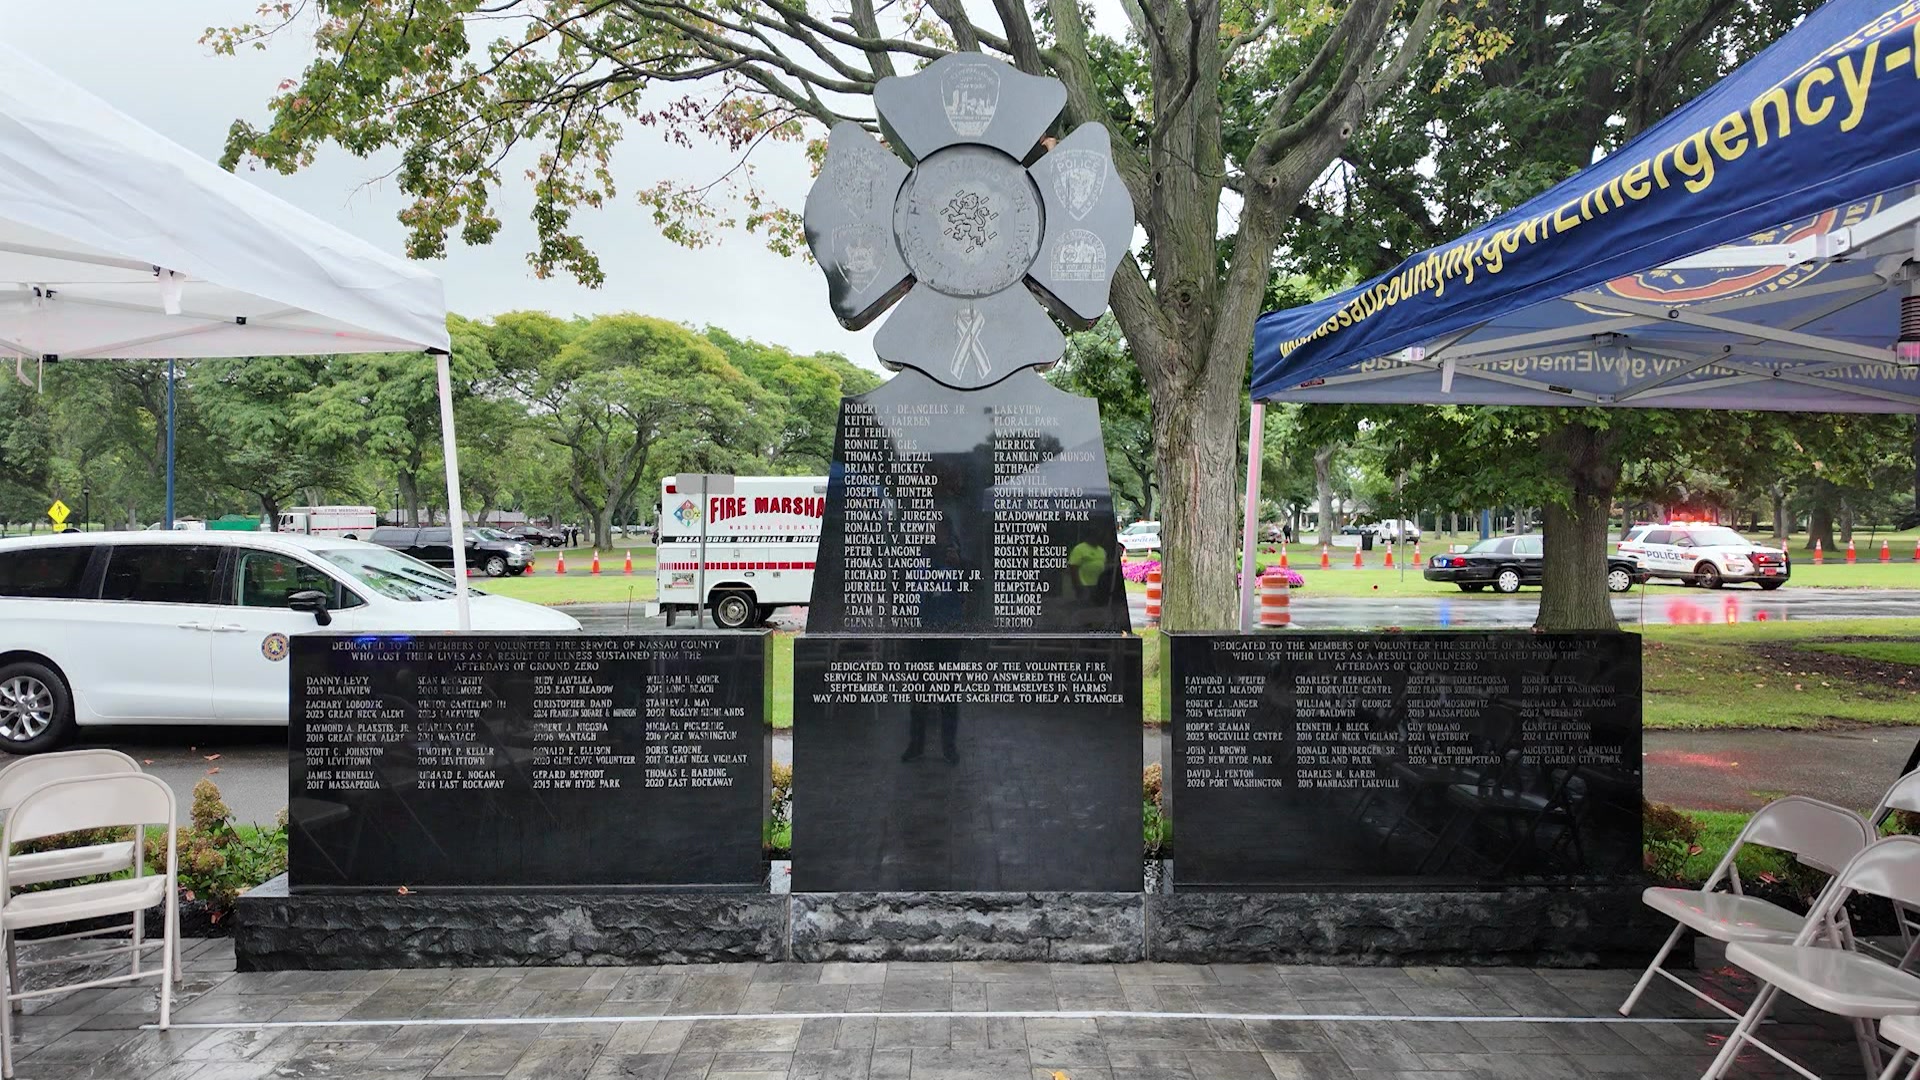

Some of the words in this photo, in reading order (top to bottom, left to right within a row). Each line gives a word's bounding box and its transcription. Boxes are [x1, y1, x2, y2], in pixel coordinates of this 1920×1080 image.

[844, 403, 878, 414] ROBERT
[898, 403, 948, 414] DEANGELIS
[954, 403, 968, 414] JR.
[844, 427, 860, 438] LEE
[865, 427, 903, 438] FEHLING
[994, 427, 1040, 438] WANTAGH
[994, 439, 1036, 450] MERRICK
[844, 451, 882, 462] THOMAS
[900, 451, 933, 462] HETZEL
[994, 451, 1038, 462] FRANKLIN
[1061, 451, 1095, 462] MUNSON
[844, 463, 874, 474] BRIAN
[878, 463, 886, 474] C.
[891, 463, 924, 474] HICKEY
[994, 463, 1040, 474] BETHPAGE
[844, 475, 880, 485] GEORGE
[885, 475, 894, 485] G.
[899, 475, 938, 485] HOWARD
[844, 487, 878, 497] JOSEPH
[884, 487, 892, 497] G.
[897, 487, 933, 497] HUNTER
[994, 487, 1024, 497] SOUTH
[1028, 487, 1083, 497] HEMPSTEAD
[844, 498, 893, 509] JONATHAN
[898, 498, 907, 509] L.
[912, 498, 934, 509] IELPI
[994, 498, 1022, 509] GREAT
[1028, 498, 1048, 509] NECK
[1055, 498, 1097, 509] VIGILANT
[710, 497, 746, 524] FIRE
[754, 497, 825, 518] MARSHA
[844, 510, 882, 521] THOMAS
[888, 510, 896, 521] E.
[902, 510, 943, 521] JURGENS
[994, 510, 1060, 521] MEADOWMERE
[1066, 510, 1089, 521] PARK
[844, 522, 881, 533] RONALD
[887, 522, 894, 533] T.
[900, 522, 936, 533] KERWIN
[994, 522, 1047, 533] LEVITTOWN
[844, 534, 886, 545] MICHAEL
[892, 534, 899, 545] V.
[906, 534, 937, 545] KIEFER
[994, 534, 1049, 545] HEMPSTEAD
[844, 546, 872, 557] PETER
[878, 546, 921, 557] LANGONE
[994, 546, 1028, 557] ROSLYN
[1033, 546, 1067, 557] RESCUE
[1646, 550, 1680, 561] POLICE
[844, 558, 882, 568] THOMAS
[888, 558, 931, 568] LANGONE
[994, 558, 1028, 568] ROSLYN
[1033, 558, 1067, 568] RESCUE
[844, 570, 886, 580] RICHARD
[892, 570, 900, 580] T.
[906, 570, 964, 580] MULDOWNEY
[969, 570, 984, 580] JR.
[994, 570, 1040, 580] FREEPORT
[844, 582, 886, 592] DURRELL
[892, 582, 900, 592] V.
[906, 582, 952, 592] PEARSALL
[958, 582, 973, 592] JR.
[994, 582, 1049, 592] HEMPSTEAD
[844, 593, 872, 604] KEVIN
[878, 593, 888, 604] M.
[893, 593, 921, 604] PRIOR
[994, 593, 1041, 604] BELLMORE
[994, 605, 1041, 616] BELLMORE
[454, 662, 509, 671] AFTERDAYS
[514, 662, 525, 671] OF
[530, 662, 570, 671] GROUND
[575, 662, 599, 671] ZERO
[831, 661, 883, 672] DEDICATED
[888, 661, 900, 672] TO
[904, 661, 934, 672] THOSE
[939, 661, 982, 672] MEMBERS
[986, 661, 998, 672] OF
[1002, 661, 1021, 672] THE
[1026, 661, 1080, 672] VOLUNTEER
[1086, 661, 1106, 672] FIRE
[1335, 662, 1389, 671] AFTERDAYS
[1394, 662, 1405, 671] OF
[1410, 662, 1449, 671] GROUND
[1454, 662, 1478, 671] ZERO
[307, 677, 340, 685] DANNY
[344, 677, 368, 685] LEVY
[824, 672, 862, 682] SERVICE
[867, 672, 877, 682] IN
[882, 672, 919, 682] NASSAU
[923, 672, 962, 682] COUNTY
[966, 672, 988, 682] WHO
[993, 672, 1044, 682] ANSWERED
[1048, 672, 1066, 682] THE
[1099, 672, 1112, 682] ON
[830, 683, 884, 693] SEPTEMBER
[902, 683, 924, 693] 2001
[930, 683, 950, 693] AND
[954, 683, 990, 693] PLACED
[995, 683, 1054, 693] THEMSELVES
[1058, 683, 1067, 693] IN
[1073, 683, 1107, 693] HARMS
[813, 693, 832, 703] WAY
[836, 693, 856, 703] AND
[861, 693, 888, 703] MADE
[892, 693, 910, 703] THE
[916, 693, 962, 703] ULTIMATE
[966, 693, 1014, 703] SACRIFICE
[1019, 693, 1032, 703] TO
[1036, 693, 1059, 703] HELP
[1064, 693, 1070, 703] A
[1075, 693, 1124, 703] STRANGER
[1408, 723, 1423, 731] GUY
[1428, 723, 1460, 731] ROMANO
[1408, 733, 1425, 741] 2021
[1430, 733, 1470, 741] WESTBURY
[1409, 756, 1427, 764] 2026
[1432, 756, 1452, 764] WEST
[1455, 756, 1501, 764] HEMPSTEAD
[307, 771, 332, 779] JAMES
[336, 771, 374, 779] KENNELLY
[645, 769, 677, 777] THOMAS
[692, 769, 726, 777] HARDING
[307, 781, 324, 789] 2017
[533, 779, 550, 788] 2015
[555, 779, 571, 788] NEW
[575, 779, 595, 788] HYDE
[600, 779, 620, 788] PARK
[645, 778, 664, 787] 2020
[668, 778, 688, 787] EAST
[692, 778, 733, 787] ROCKAWAY
[1187, 779, 1205, 787] 2026
[1210, 779, 1228, 787] PORT
[1233, 779, 1282, 787] WASHINGTON
